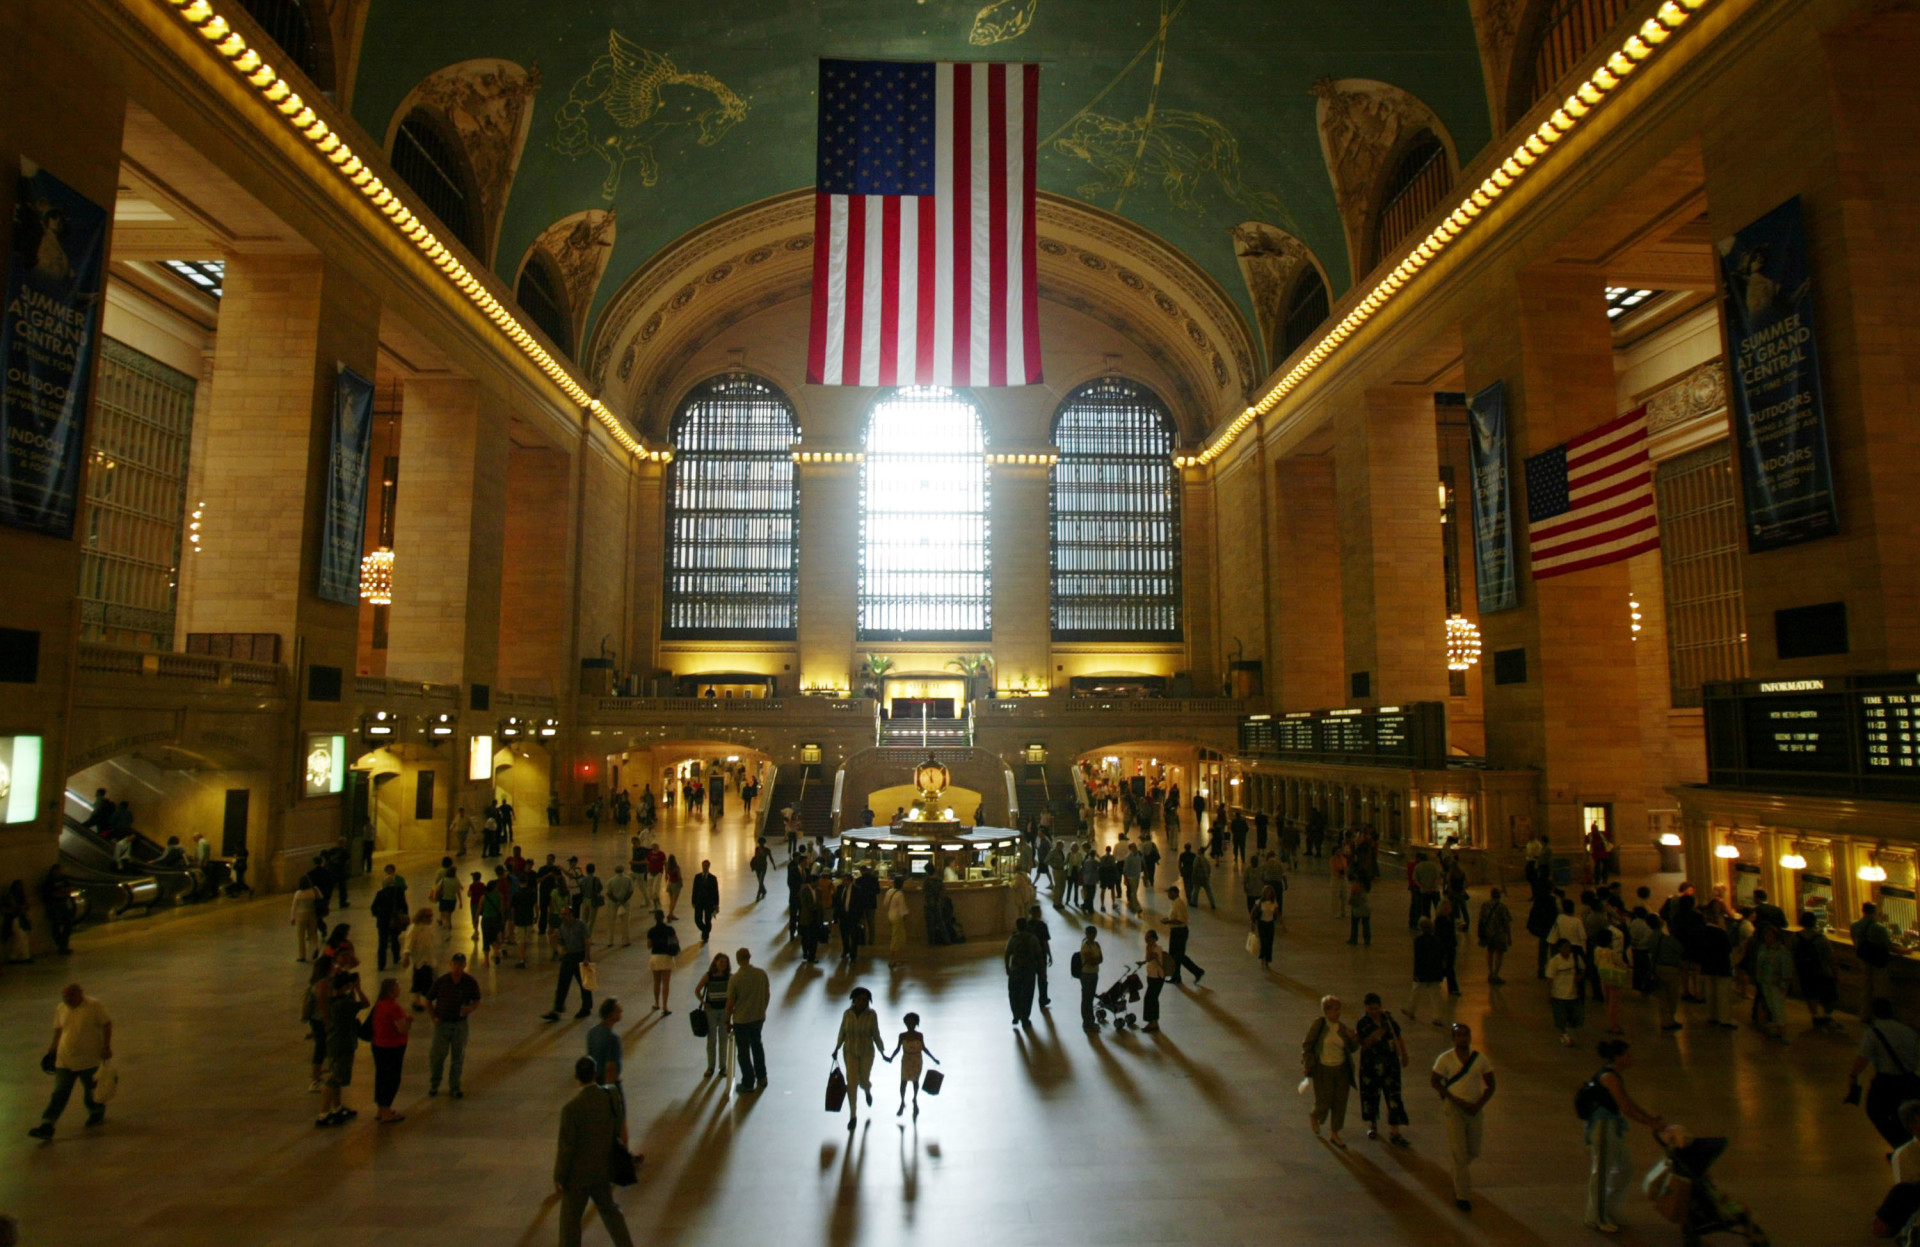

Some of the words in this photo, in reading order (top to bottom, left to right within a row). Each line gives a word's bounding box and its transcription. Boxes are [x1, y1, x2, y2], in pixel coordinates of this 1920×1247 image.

[20, 284, 85, 326] SUMMER
[8, 298, 28, 317] AT
[30, 309, 88, 346] GRAND
[1741, 313, 1801, 354] SUMMER
[1737, 354, 1754, 372] AT
[1756, 326, 1810, 362] GRAND
[1743, 346, 1806, 385] CENTRAL
[7, 368, 75, 405] OUTDOORS
[1748, 390, 1813, 425] OUTDOORS
[7, 426, 64, 456] INDOORS
[1758, 446, 1812, 473] INDOORS
[1760, 680, 1824, 692] INFORMATION
[1863, 696, 1884, 704] TIME
[1888, 696, 1906, 704] TRK
[1866, 708, 1885, 717] 11:02
[1868, 721, 1887, 729] 11:23
[1900, 721, 1909, 729] 23
[1870, 746, 1888, 754] 12:02
[1870, 758, 1890, 766] 12:23
